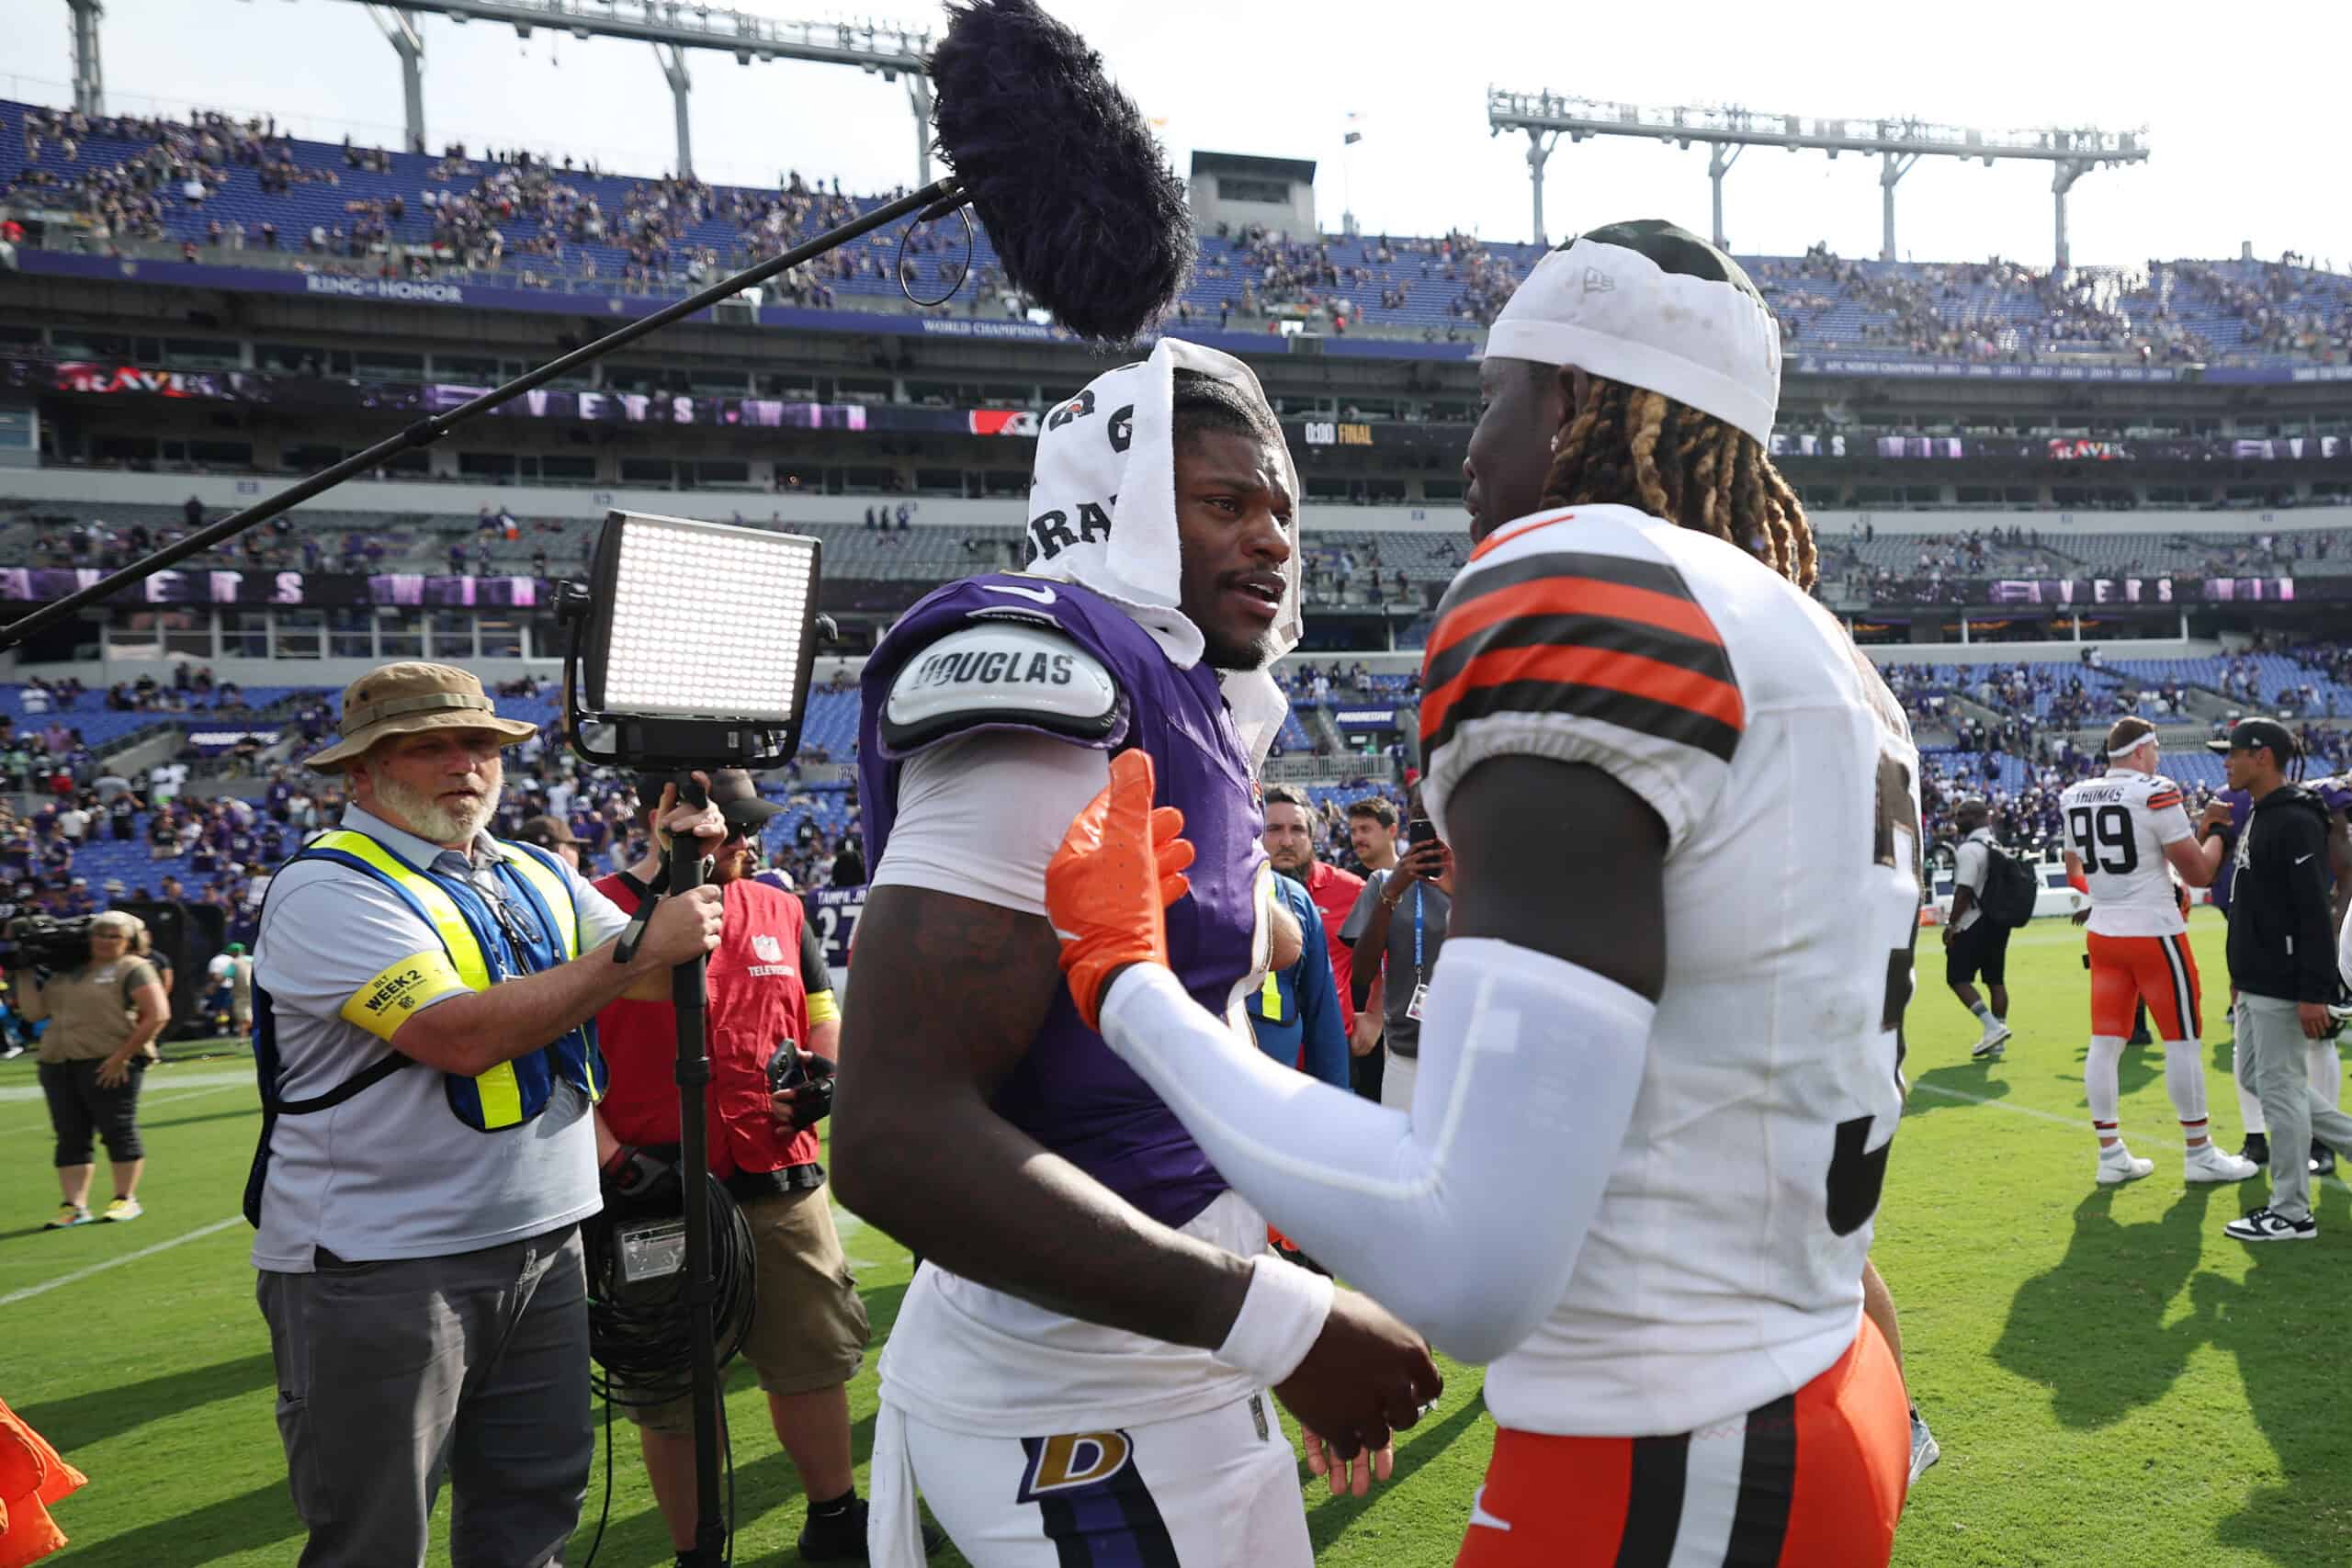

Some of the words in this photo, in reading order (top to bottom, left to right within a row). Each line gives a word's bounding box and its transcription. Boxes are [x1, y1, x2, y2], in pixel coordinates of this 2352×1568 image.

[379, 281, 463, 303] HONOR
[922, 321, 971, 334] WORLD
[973, 321, 1048, 337] CHAMPIONS
[1338, 423, 1374, 446] FINAL
[2075, 785, 2125, 804] THOMAS
[2069, 804, 2139, 874] 99
[817, 891, 850, 905] TAMPA
[817, 906, 864, 952] 27
[747, 964, 795, 978] TELEV
[364, 976, 409, 1012] WEEK
[406, 969, 423, 982] 2
